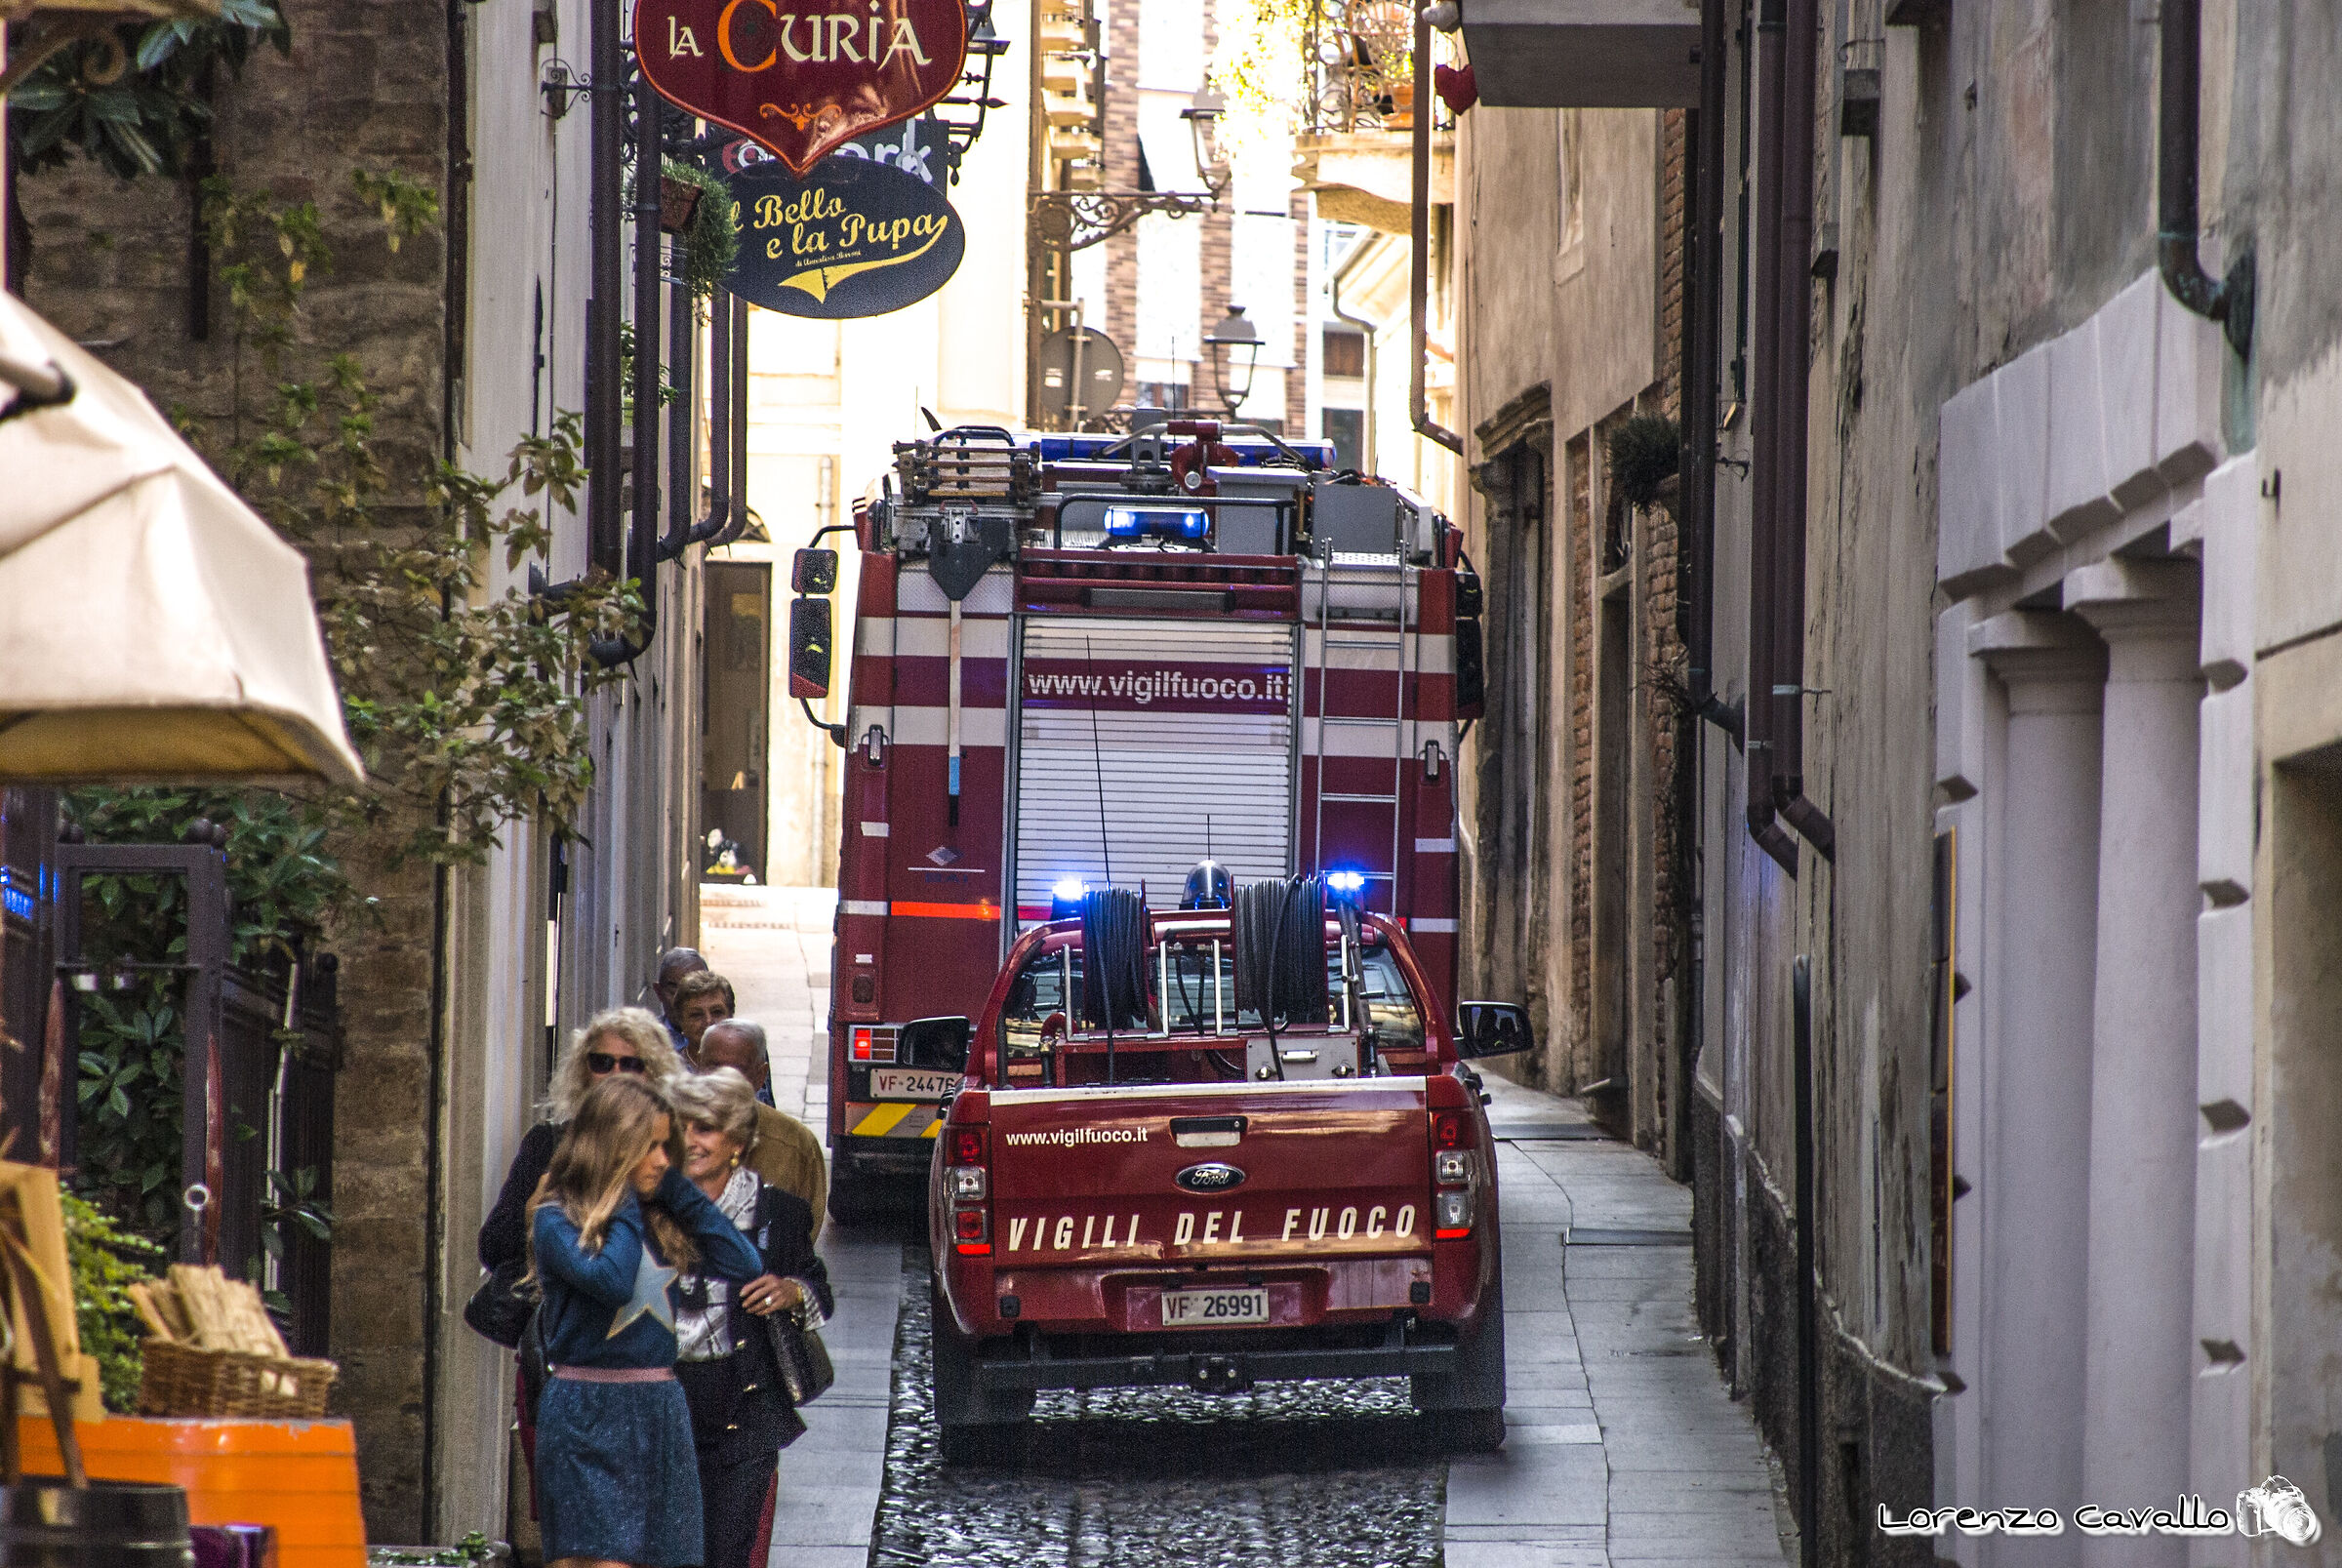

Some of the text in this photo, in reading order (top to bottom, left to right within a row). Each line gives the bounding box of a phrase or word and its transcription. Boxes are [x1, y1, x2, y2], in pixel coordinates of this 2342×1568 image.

[753, 187, 847, 229] Bello
[766, 212, 940, 260] e la Pupa
[1028, 670, 1284, 704] www.vigilfuoco.it
[879, 1075, 898, 1091] VF
[1006, 1127, 1148, 1147] www.vigilfuoco.it
[1191, 1169, 1230, 1186] Ford
[1008, 1204, 1416, 1251] VIGILI DEL FUOCO
[1166, 1295, 1262, 1318] VF 26991
